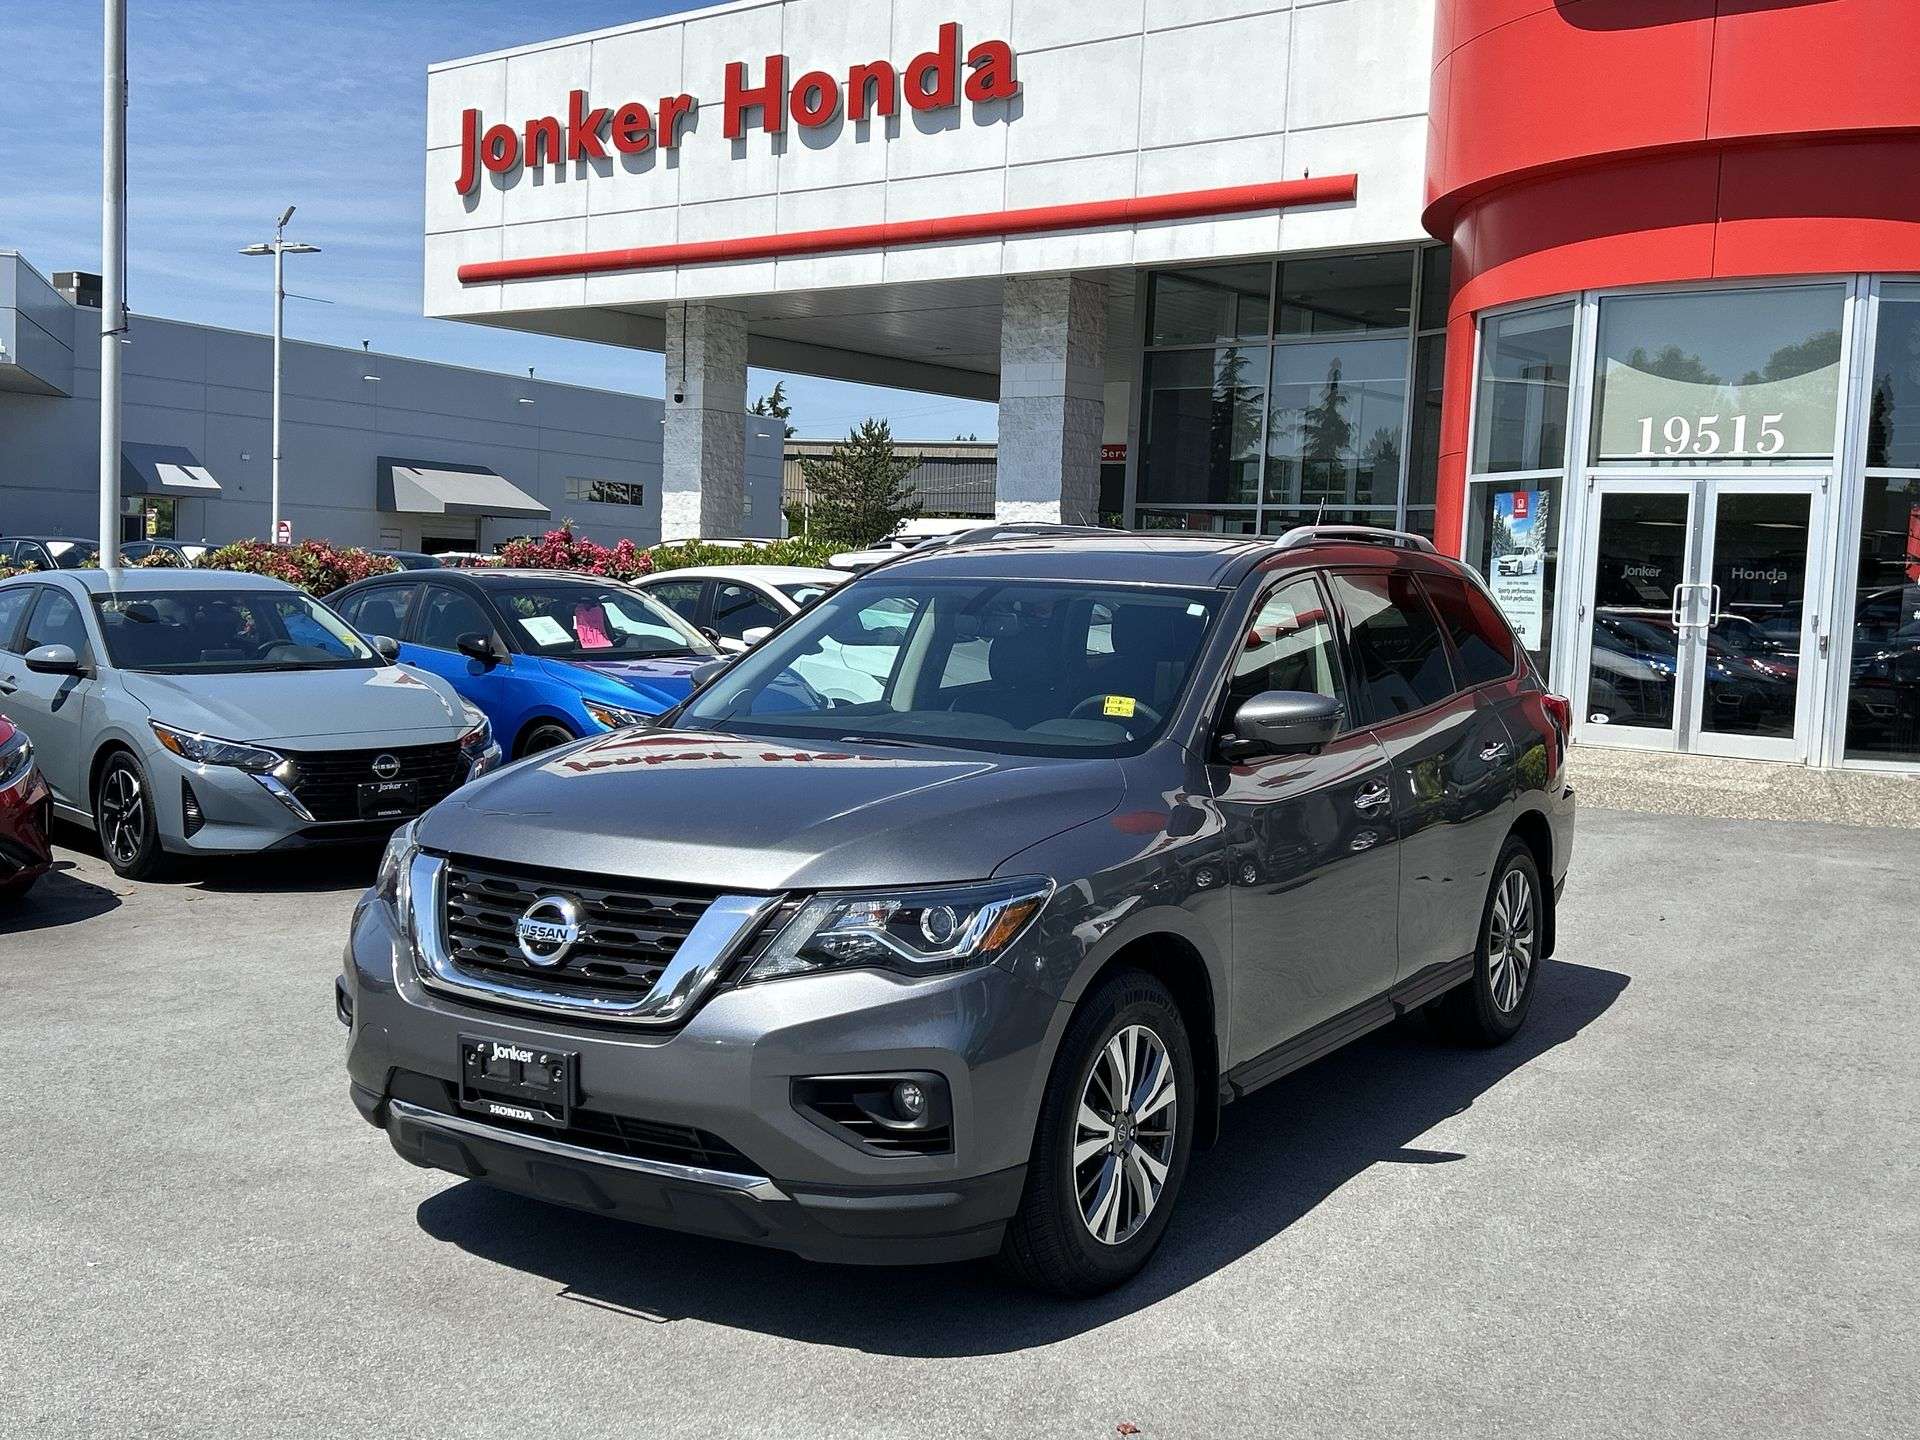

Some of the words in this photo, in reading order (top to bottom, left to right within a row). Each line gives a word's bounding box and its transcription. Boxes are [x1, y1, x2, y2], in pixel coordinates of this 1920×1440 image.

[455, 89, 699, 196] Jonker
[722, 21, 1022, 141] Honda
[1635, 412, 1785, 456] 19515
[1620, 564, 1662, 579] Jonker
[1731, 567, 1788, 581] Honda
[519, 923, 569, 939] NISSAN
[491, 1042, 534, 1063] Jonker
[489, 1104, 534, 1121] HONDA
